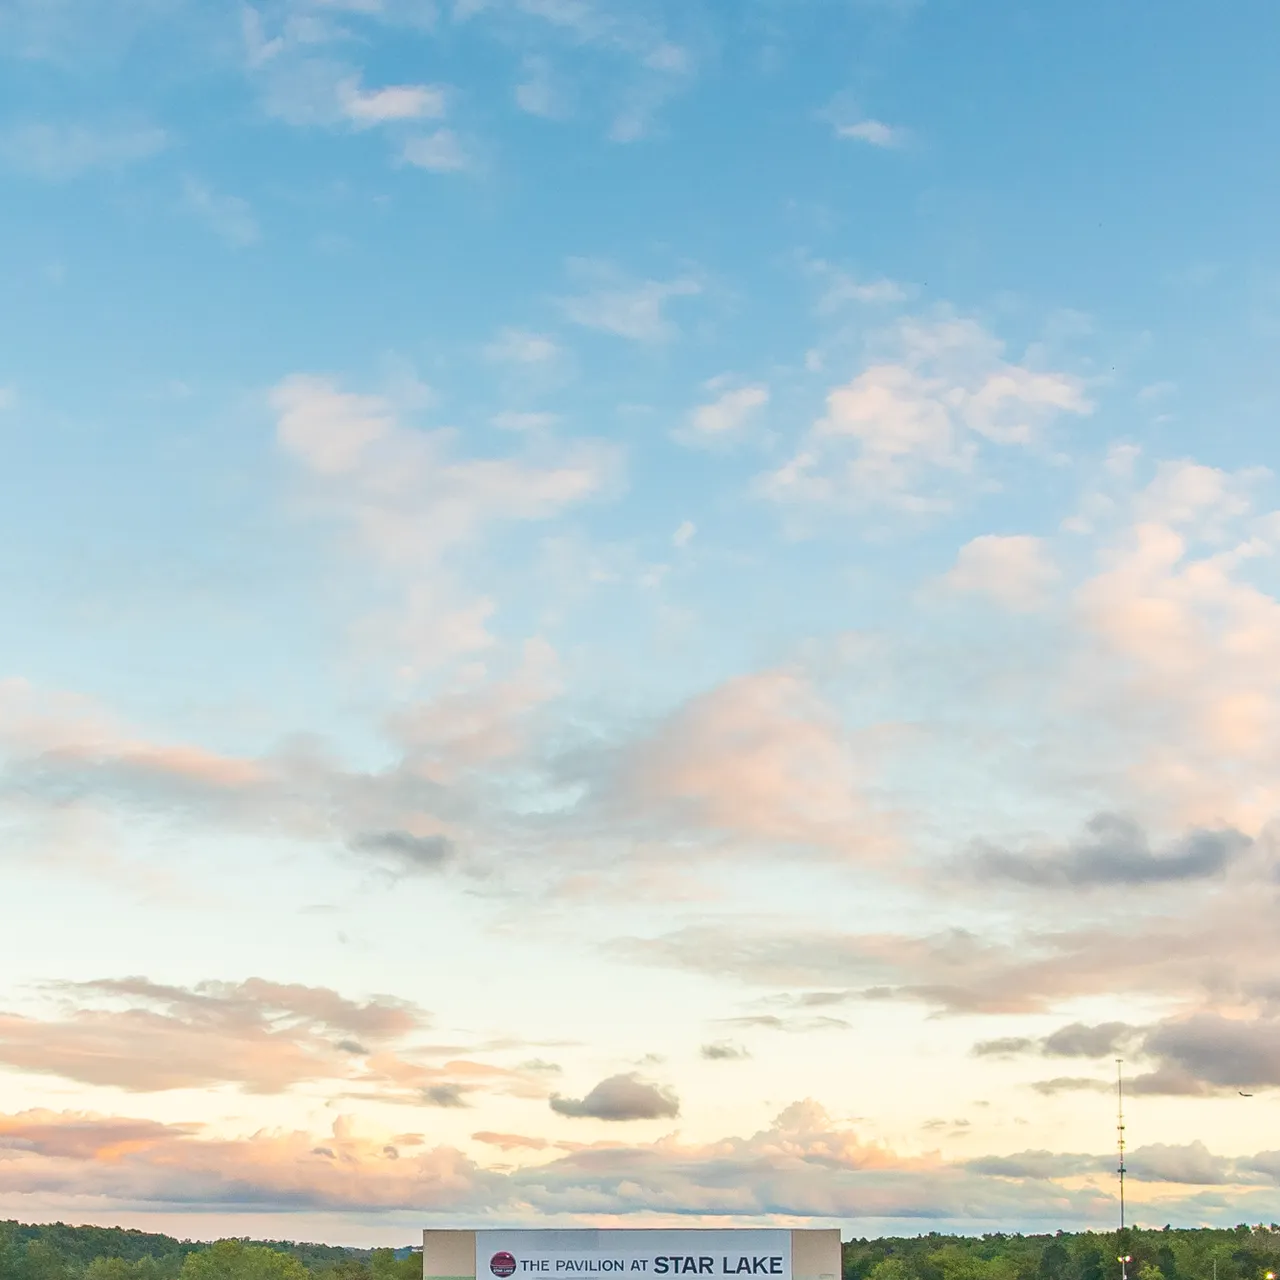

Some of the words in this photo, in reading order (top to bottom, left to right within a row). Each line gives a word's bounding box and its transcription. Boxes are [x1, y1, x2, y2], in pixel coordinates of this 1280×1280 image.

[520, 1259, 550, 1272] THE
[556, 1259, 625, 1272] PAVILION
[630, 1259, 649, 1272] AT
[654, 1256, 714, 1275] STAR
[722, 1256, 783, 1274] LAKE
